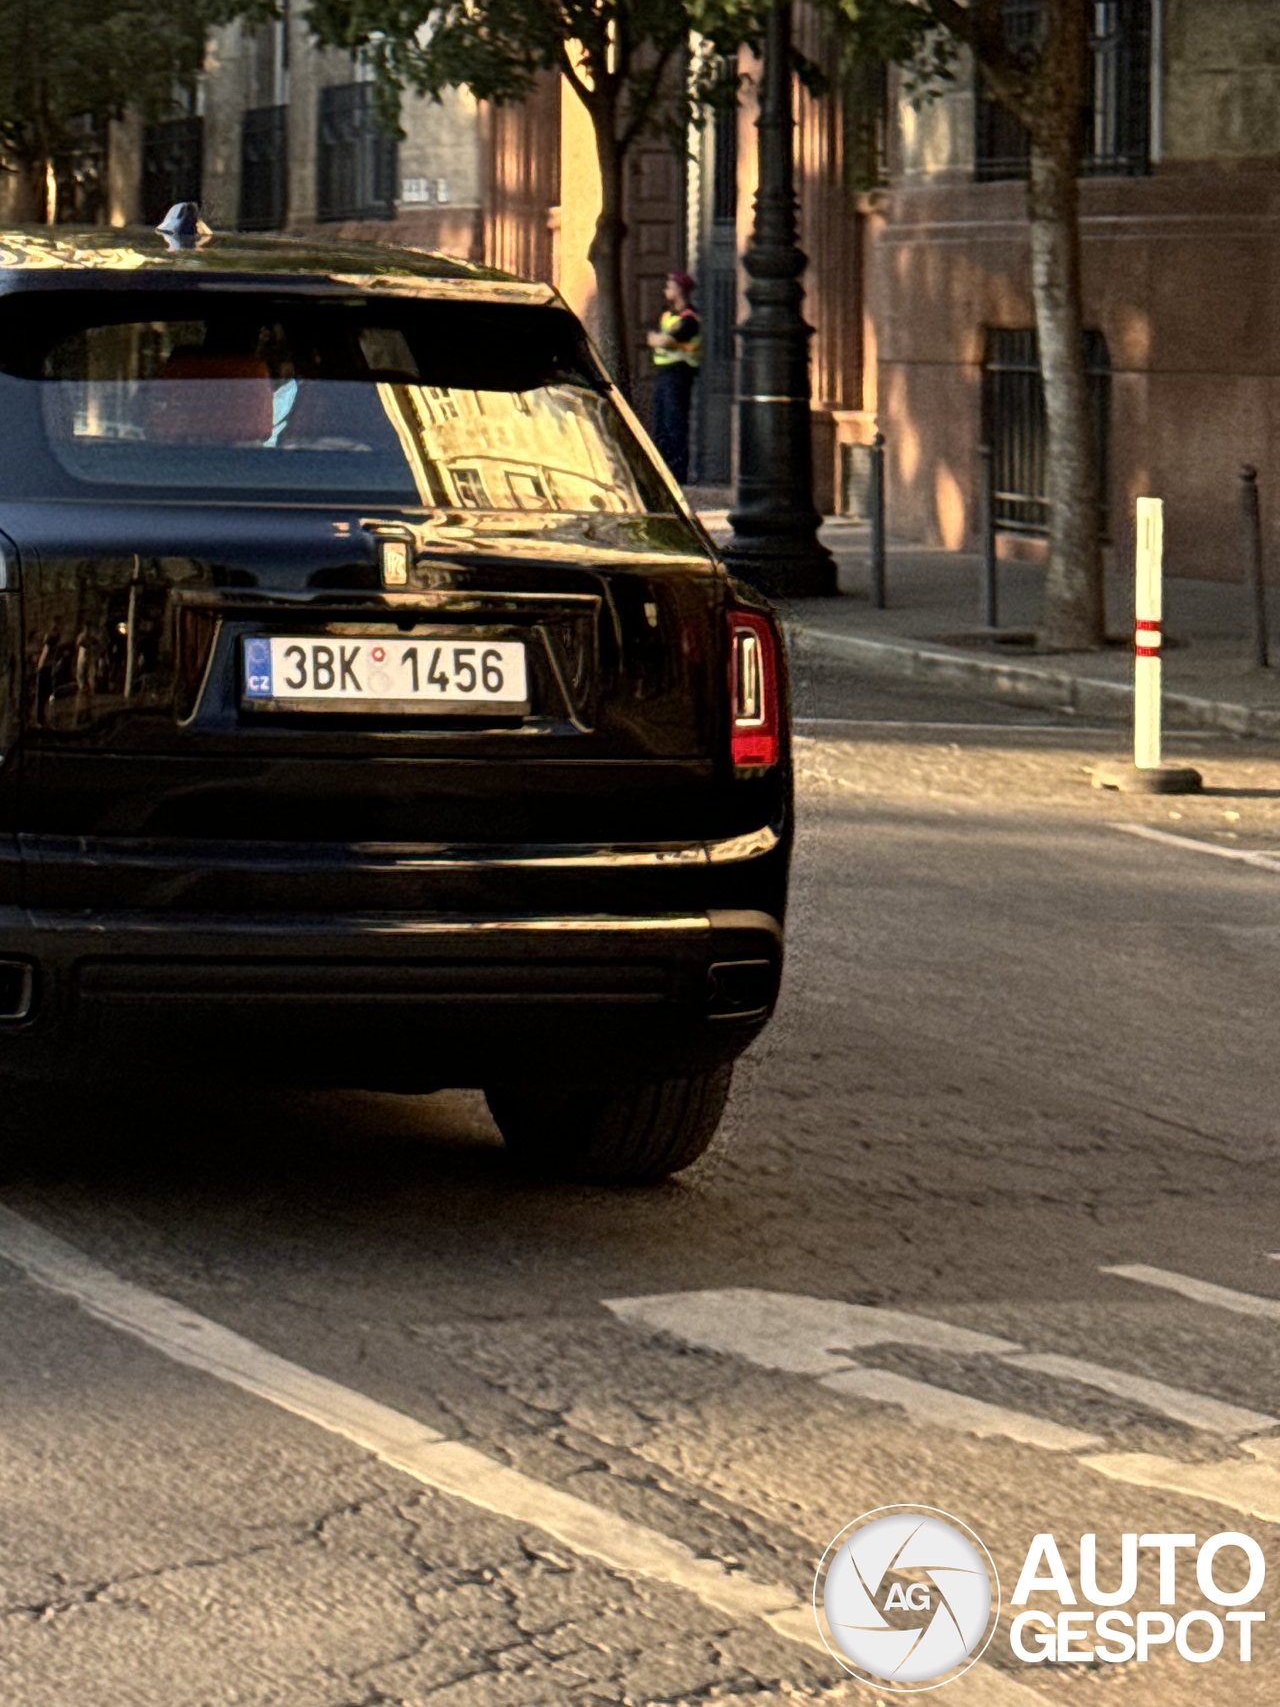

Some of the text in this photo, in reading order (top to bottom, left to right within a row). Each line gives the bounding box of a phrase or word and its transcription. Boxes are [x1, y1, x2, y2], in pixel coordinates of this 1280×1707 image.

[248, 675, 270, 691] CZ
[283, 644, 504, 694] 3BK 1456
